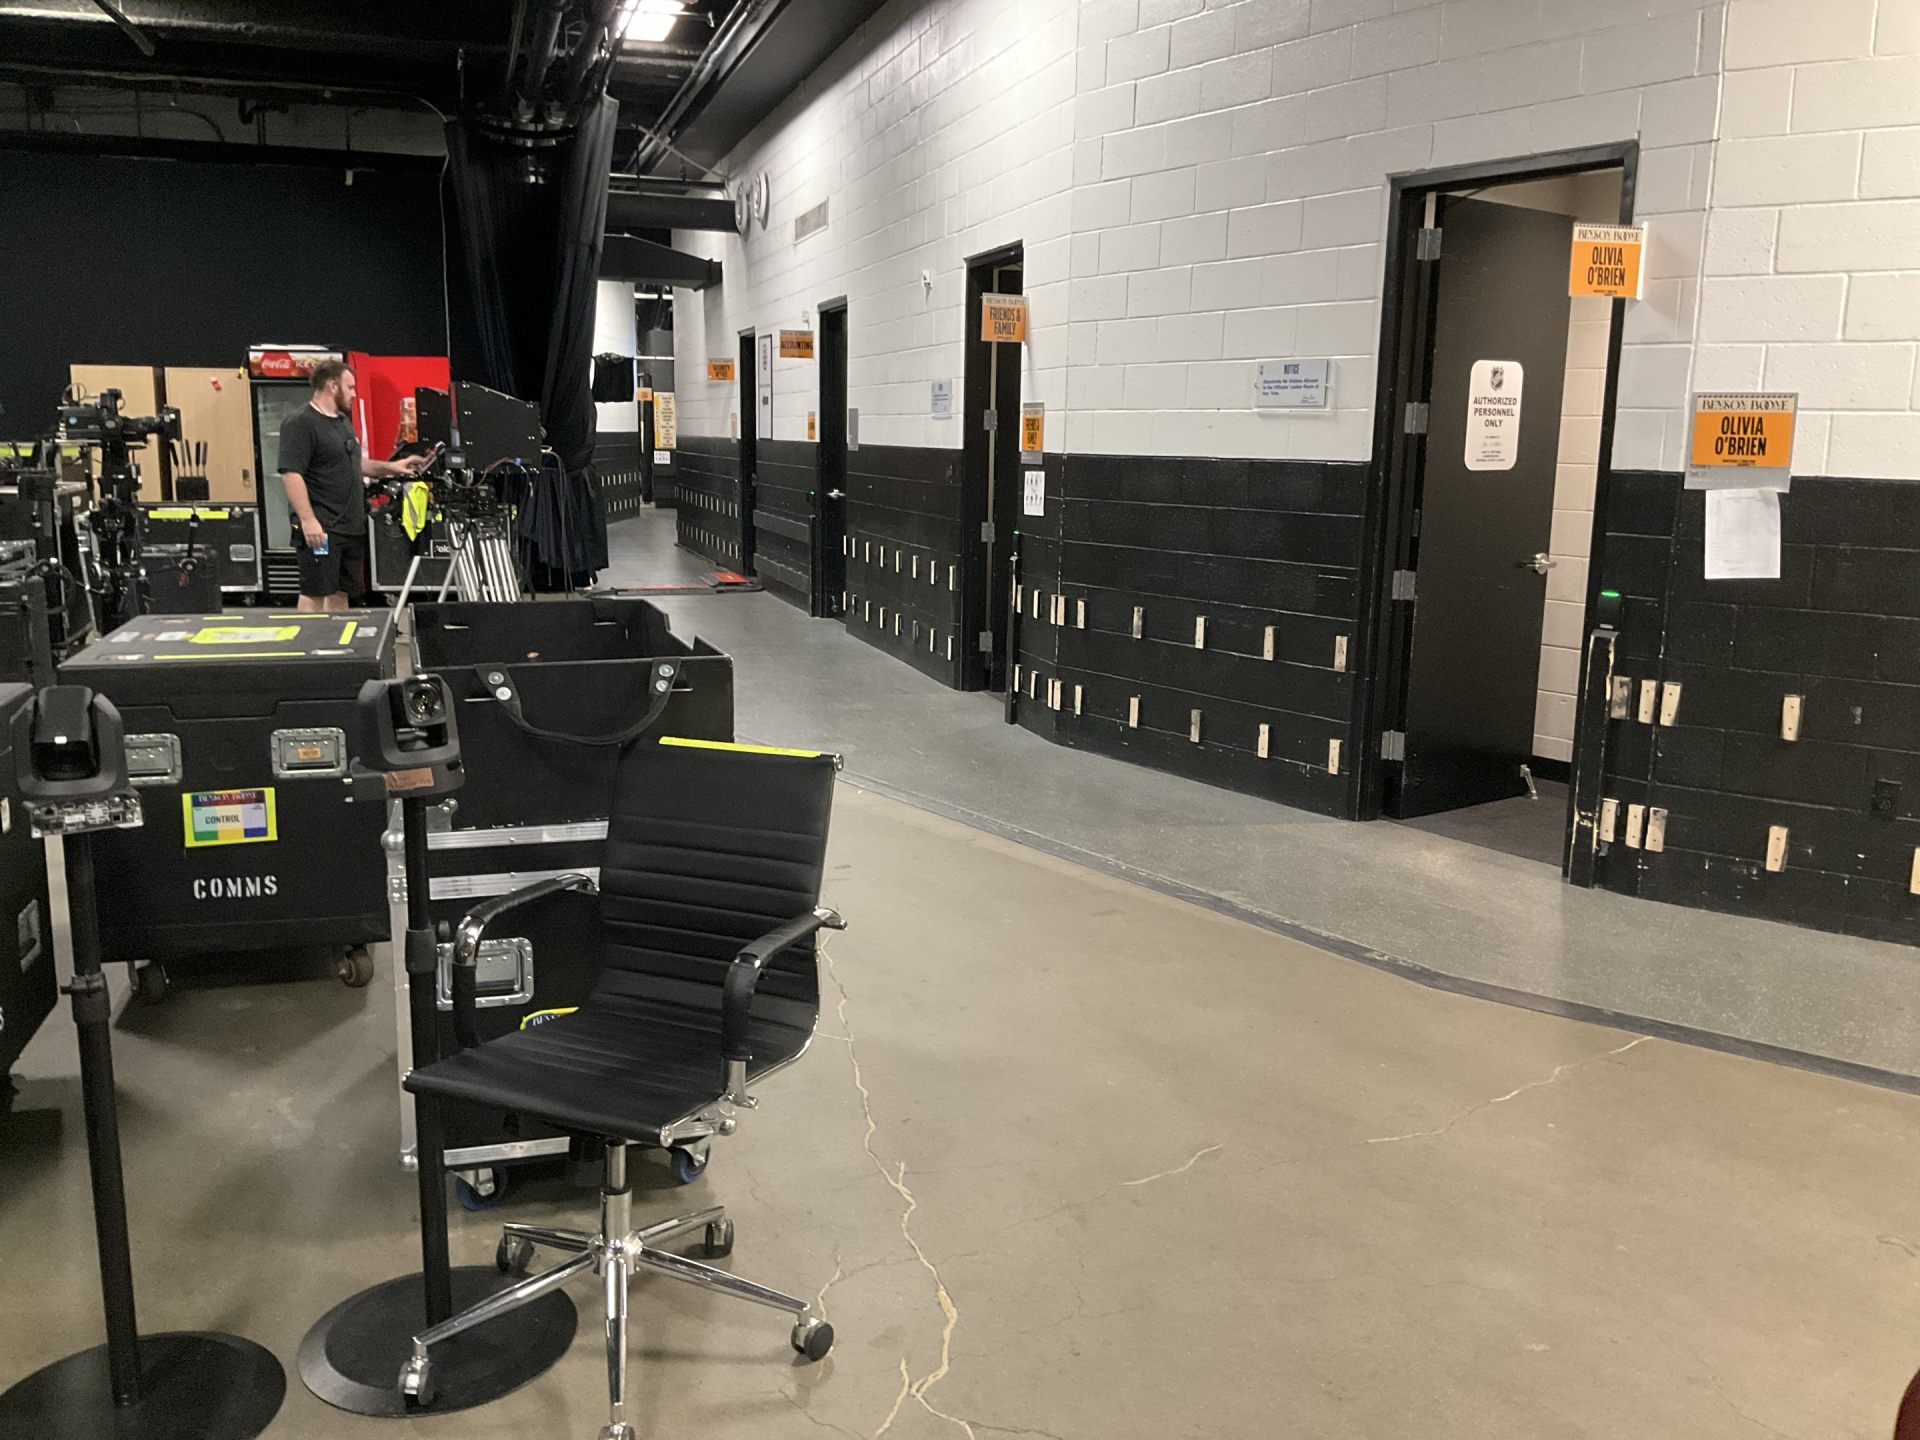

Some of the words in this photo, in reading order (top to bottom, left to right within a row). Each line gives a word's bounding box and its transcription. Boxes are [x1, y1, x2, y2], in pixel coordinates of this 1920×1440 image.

[1578, 229, 1611, 241] BENSON
[1613, 230, 1641, 242] BOONE
[1592, 246, 1623, 266] OLIVIA
[1587, 266, 1626, 286] O'BRIEN
[990, 306, 1015, 321] FRIENDS
[1016, 308, 1021, 322] &
[994, 321, 1017, 335] FAMILY
[780, 341, 813, 350] ACCOUNTING
[1283, 364, 1300, 374] NOTICE
[1473, 396, 1518, 406] AUTHORIZED
[1702, 399, 1748, 410] BENSON
[1750, 400, 1789, 410] BOONE
[1473, 408, 1515, 417] PERSONNEL
[1484, 419, 1503, 428] ONLY
[1720, 416, 1764, 435] OLIVIA
[1714, 436, 1767, 456] O'BRIEN
[205, 814, 241, 825] CONTROL
[193, 875, 278, 899] COMMS
